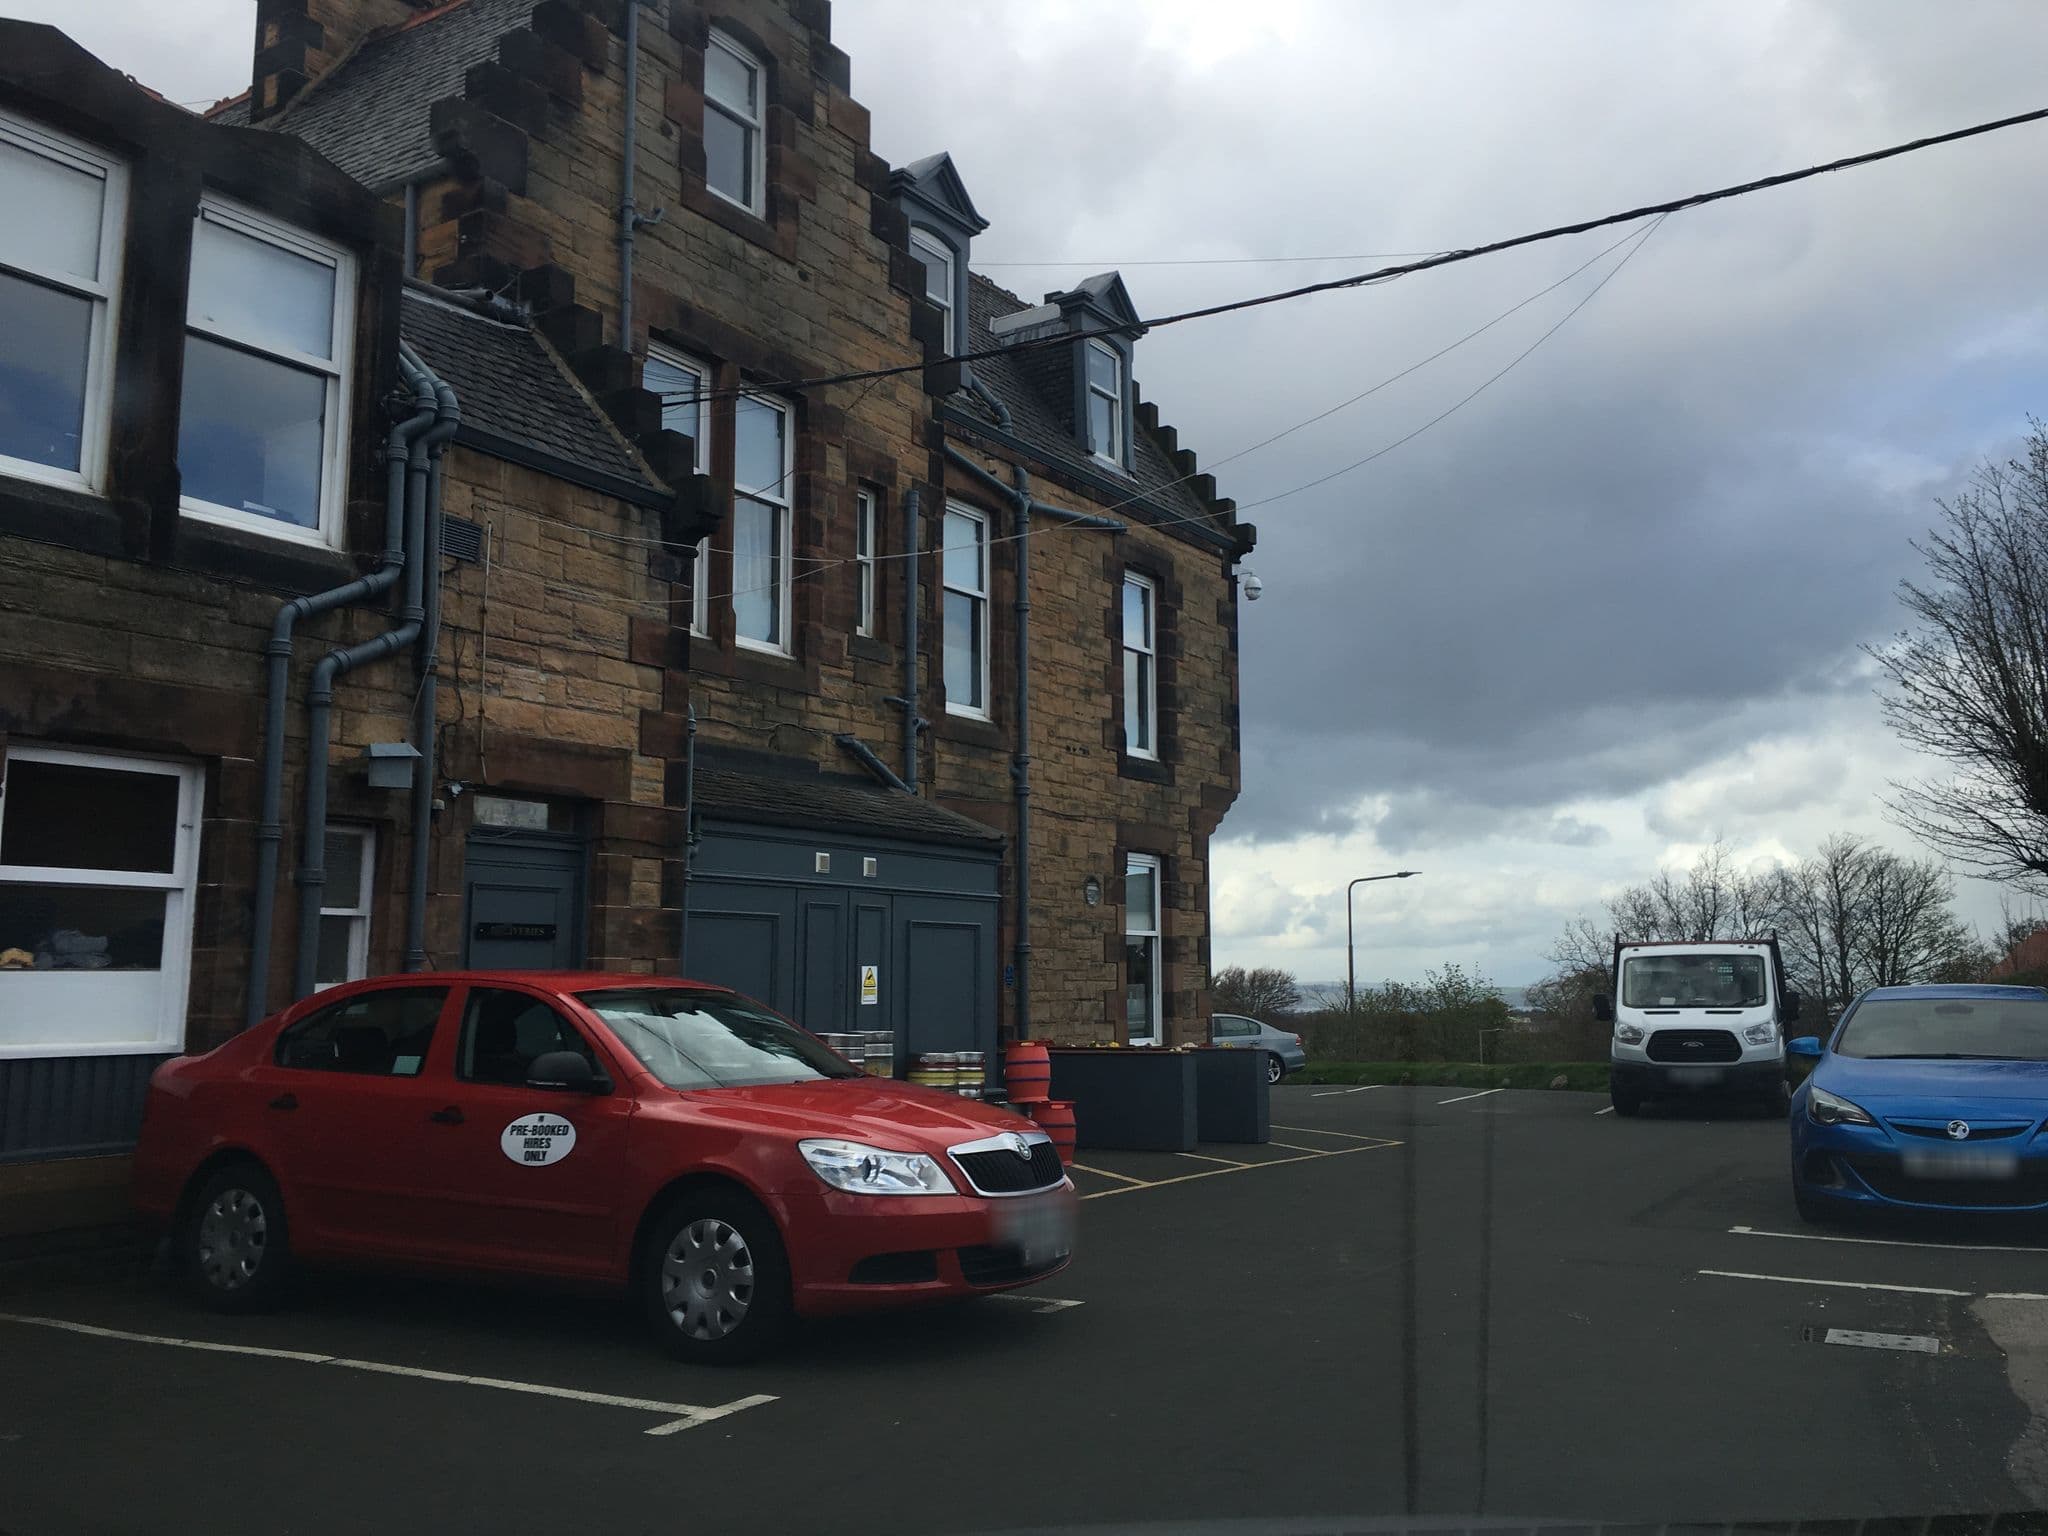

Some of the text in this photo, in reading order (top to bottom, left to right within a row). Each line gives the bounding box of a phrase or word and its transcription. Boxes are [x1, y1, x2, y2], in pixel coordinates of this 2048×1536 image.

[490, 925, 545, 937] LIVERIES
[510, 1124, 569, 1136] PRE-BOOKED
[523, 1137, 552, 1148] HIRES
[524, 1150, 548, 1162] ONLY
